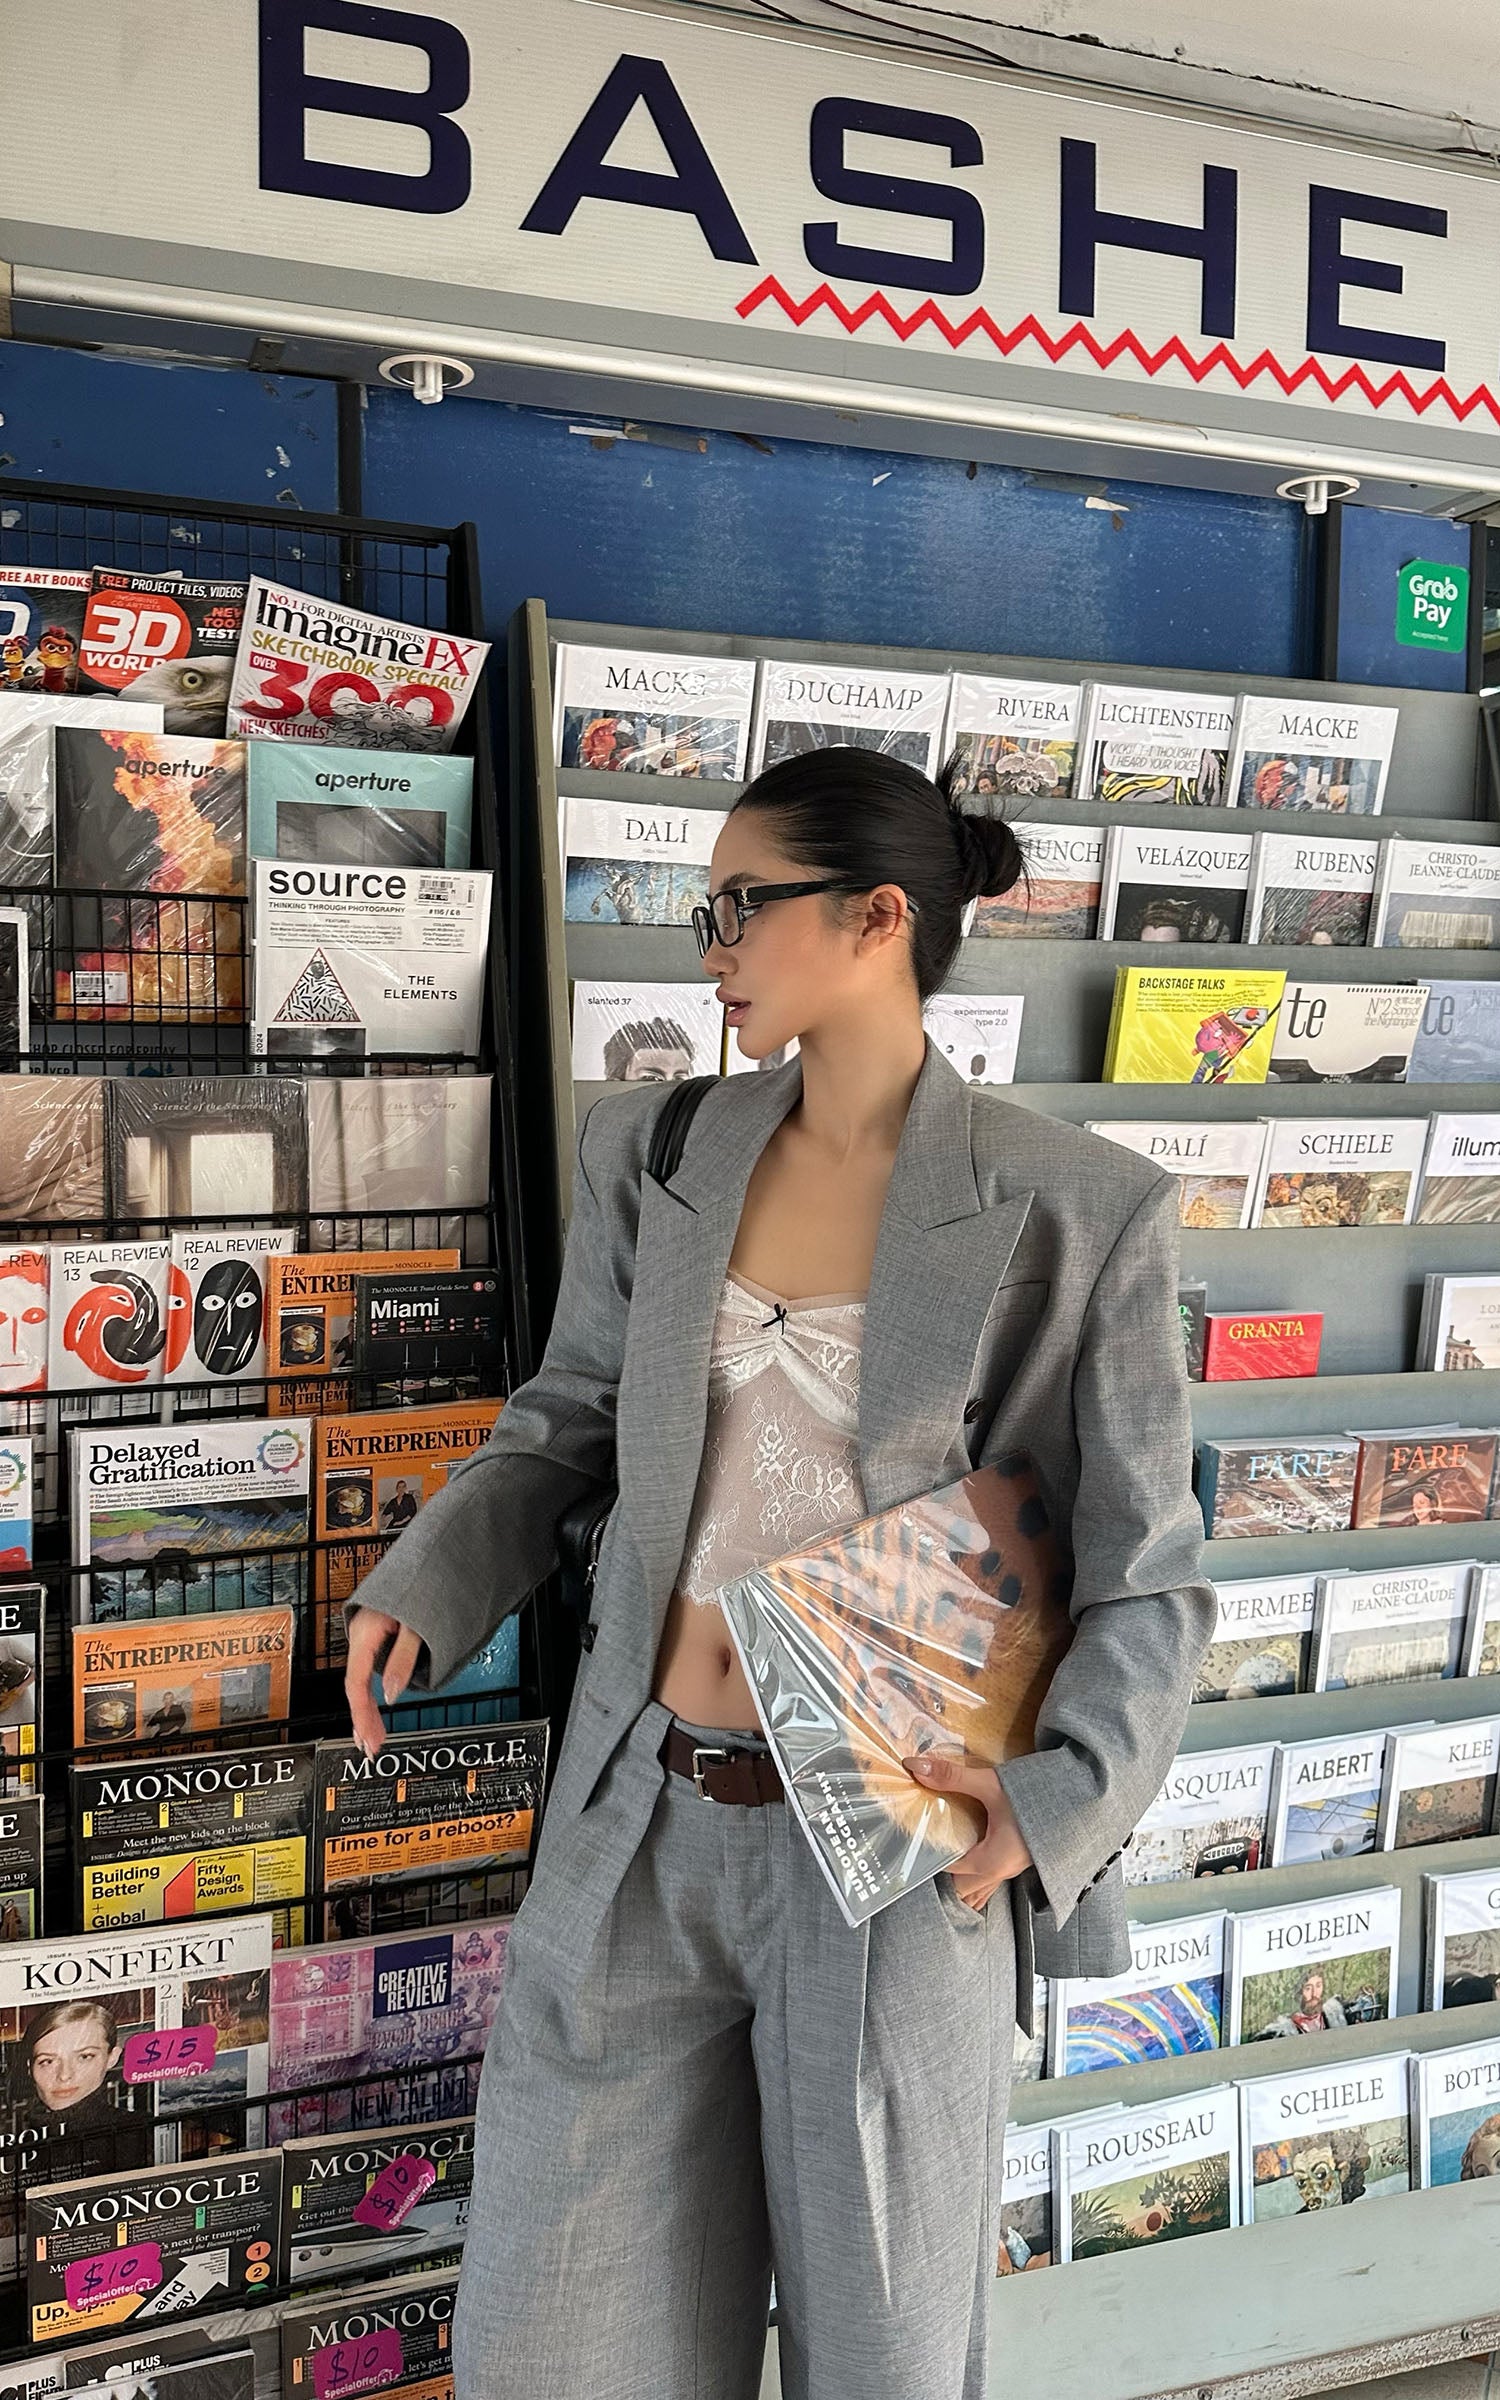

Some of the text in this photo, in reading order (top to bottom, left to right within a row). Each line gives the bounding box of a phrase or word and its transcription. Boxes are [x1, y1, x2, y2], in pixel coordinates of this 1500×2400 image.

[258, 0, 1448, 373] BASHE
[24, 573, 91, 589] ART BOOKS
[99, 574, 244, 599] FREE PROJECT FILES, VIDEOS
[1409, 575, 1459, 601] Grab
[270, 591, 425, 645] NO.1 FOR DIGITAL ARTISTS
[1413, 597, 1452, 629] Pay
[80, 604, 181, 657] 3D
[257, 587, 479, 676] ImagineFX
[252, 629, 468, 692] SKETCHBOOK SPECIAL!
[252, 656, 278, 671] OVER
[241, 658, 455, 727] 300
[605, 666, 707, 697] MACKE
[787, 679, 923, 712] DUCHAMP
[997, 696, 1070, 722] RIVERA
[1099, 703, 1234, 732] LICHTENSTEIN
[239, 718, 329, 740] NEW SKETCHES!
[1279, 714, 1359, 740] MACKE
[126, 757, 227, 781] aperture
[1119, 757, 1148, 768] HEARD
[1150, 758, 1173, 770] YOUR
[1174, 760, 1199, 772] VOICE
[315, 771, 412, 793] aperture
[625, 818, 689, 844] DALÍ
[1136, 845, 1250, 872] VELÁZQUEZ
[1295, 849, 1376, 876] RUBENS
[1428, 851, 1478, 866] CHRISTO
[268, 869, 407, 899] source
[1409, 863, 1500, 881] JEANNE-CLAUDE
[268, 901, 406, 914] THINKING THROUGH PHOTOGRAPHY
[407, 975, 435, 986] THE
[1138, 977, 1195, 990] BACKSTAGE
[1196, 978, 1226, 990] TALKS
[384, 989, 458, 1001] ELEMENTS
[588, 997, 632, 1006] slanted 37
[954, 1008, 1009, 1018] experimental
[975, 1018, 1008, 1027] type 2.0
[1287, 987, 1328, 1039] te
[152, 1101, 222, 1114] Science of the
[1148, 1134, 1208, 1158] DALÍ
[1299, 1134, 1394, 1155] SCHIELE
[1451, 1136, 1500, 1157] illum
[63, 1246, 171, 1265] REAL REVIEW
[184, 1237, 283, 1254] REAL REVIEW
[63, 1268, 81, 1281] 13
[280, 1264, 305, 1276] The
[394, 1261, 432, 1269] MONOCLE
[371, 1286, 382, 1294] The
[383, 1285, 418, 1293] MONOCLE
[436, 1284, 453, 1292] Guide
[370, 1297, 440, 1320] Miami
[1228, 1320, 1305, 1340] GRANTA
[326, 1426, 351, 1438] The
[442, 1418, 482, 1428] MONOCLE
[90, 1438, 200, 1468] Delayed
[326, 1427, 492, 1458] ENTREPRENEUR
[1248, 1451, 1334, 1481] FARE
[1391, 1443, 1469, 1472] FARE
[89, 1456, 256, 1486] Gratification
[1372, 1577, 1428, 1596] CHRISTO
[1219, 1591, 1315, 1622] VERMEE
[1352, 1588, 1456, 1614] JEANNE-CLAUDE
[84, 1639, 112, 1653] The
[84, 1631, 286, 1673] ENTREPRENEURS
[340, 1738, 527, 1782] MONOCLE
[1449, 1738, 1494, 1764] KLEE
[1297, 1752, 1374, 1785] ALBERT
[98, 1758, 296, 1806] MONOCLE
[1155, 1765, 1264, 1802] ASQUIAT
[341, 1793, 521, 1825] Our editors' top tips for the year to come
[123, 1820, 271, 1849] Meet the new kids on the block
[327, 1813, 516, 1854] Time for a reboot?
[815, 1771, 881, 1895] PHOTOGRAPHY
[197, 1862, 226, 1877] Fifty
[819, 1810, 870, 1903] EUROPEAN
[92, 1866, 160, 1885] Building
[197, 1872, 241, 1888] Design
[92, 1882, 145, 1900] Better
[196, 1883, 245, 1899] Awards
[92, 1909, 146, 1929] Global
[1266, 1910, 1371, 1952] HOLBEIN
[23, 1937, 235, 1991] KONFEKT
[378, 1961, 448, 1994] CREATIVE
[160, 1984, 176, 2000] 2.
[387, 1985, 447, 2013] REVIEW
[137, 2037, 199, 2067] $15
[131, 2066, 188, 2082] SpecialOffer
[351, 2092, 393, 2122] NEW
[398, 2078, 466, 2112] TALENT
[1280, 2077, 1384, 2120] SCHIELE
[1086, 2111, 1217, 2168] ROUSSEAU
[52, 2171, 261, 2231] MONOCLE
[299, 2207, 337, 2222] Get out
[174, 2223, 262, 2249] next for transport?
[80, 2258, 139, 2296] $10
[77, 2284, 135, 2307] SpecialOffer
[36, 2304, 69, 2322] Up,
[133, 2354, 161, 2371] PLUS
[327, 2346, 380, 2384] $10
[408, 2357, 443, 2373] let's get
[28, 2376, 56, 2392] PLUS
[324, 2375, 378, 2400] SpecialOffer
